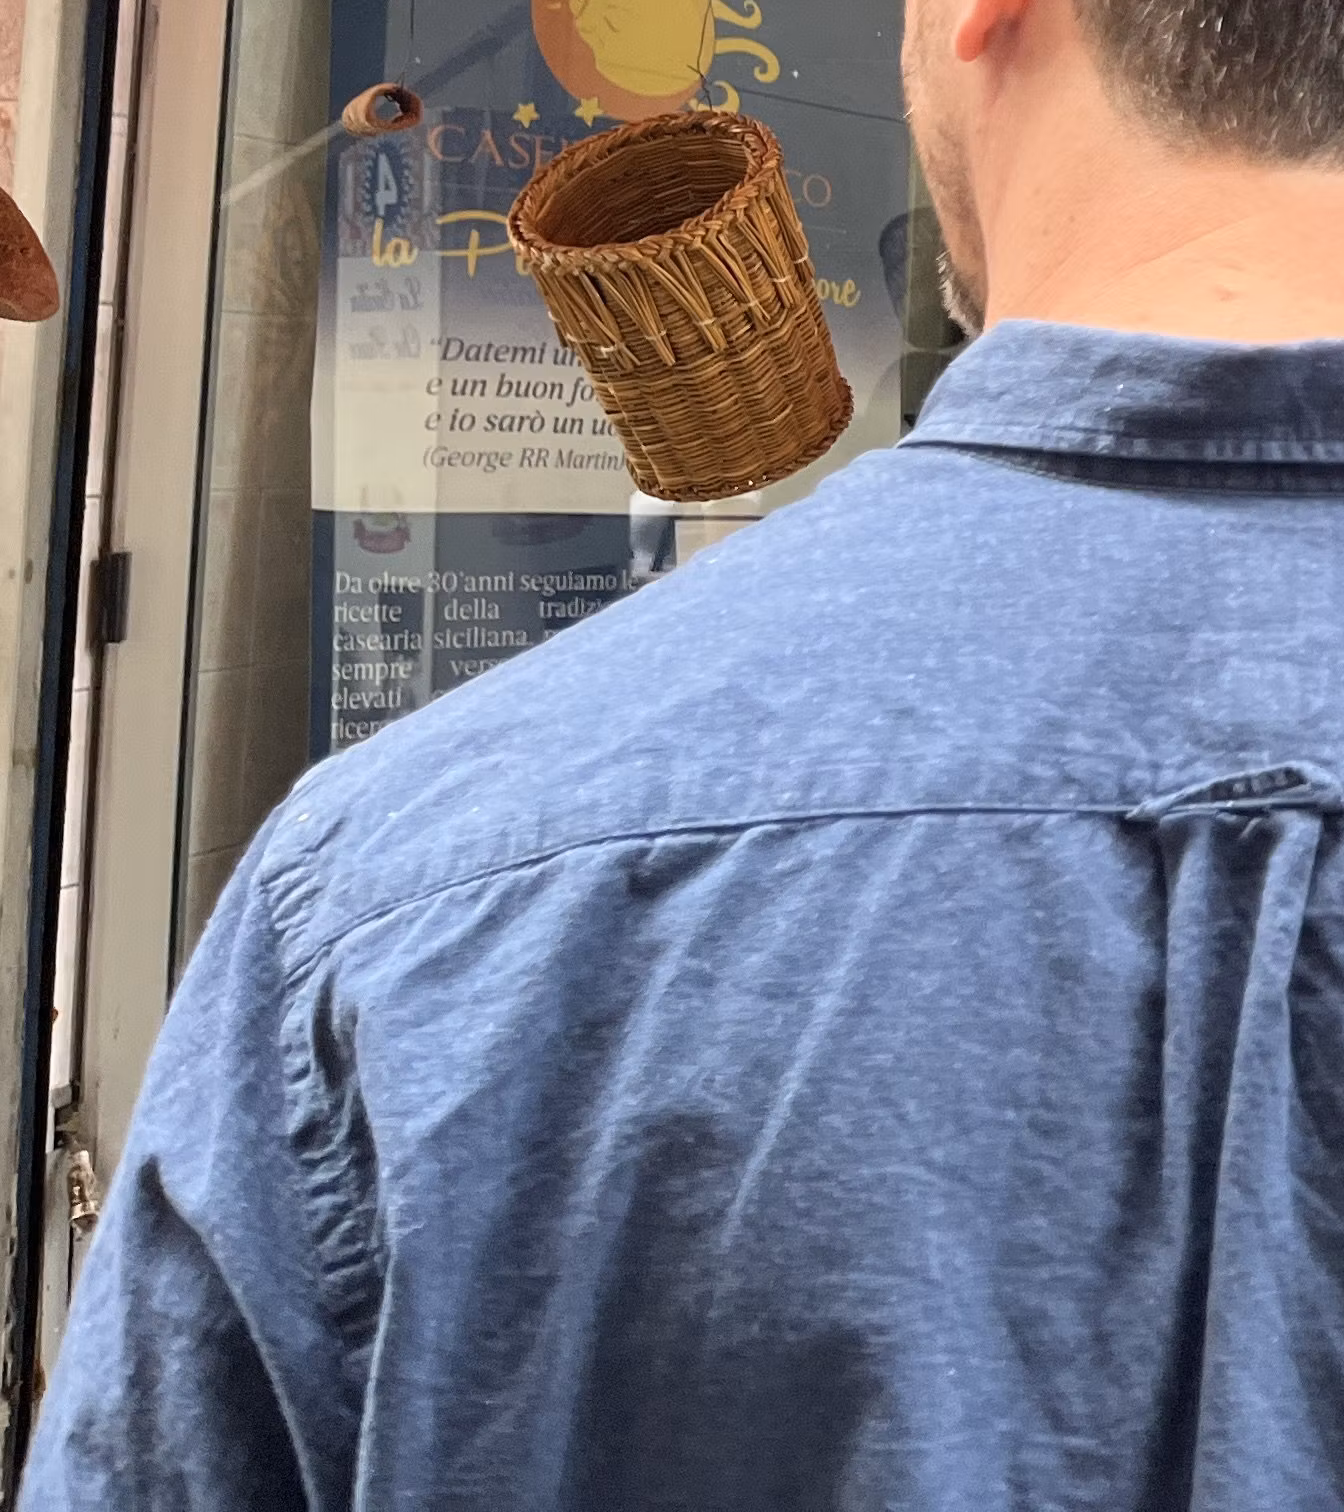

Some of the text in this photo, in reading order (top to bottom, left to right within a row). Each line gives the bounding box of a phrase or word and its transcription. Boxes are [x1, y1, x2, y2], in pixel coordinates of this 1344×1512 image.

[373, 218, 418, 267] la
[426, 378, 442, 394] e
[451, 379, 486, 396] un
[496, 374, 564, 400] buon
[425, 414, 440, 430] e
[449, 410, 476, 431] io
[483, 410, 545, 433] sarò
[553, 416, 584, 435] un
[423, 447, 513, 472] (George
[519, 448, 550, 468] RR
[334, 571, 362, 593] Da
[368, 571, 420, 594] oltre
[520, 571, 617, 596] seguiamo
[334, 601, 402, 623] ricette
[444, 598, 500, 620] della
[333, 629, 422, 651] casearia
[332, 661, 413, 686] sempre
[331, 687, 401, 710] elevati
